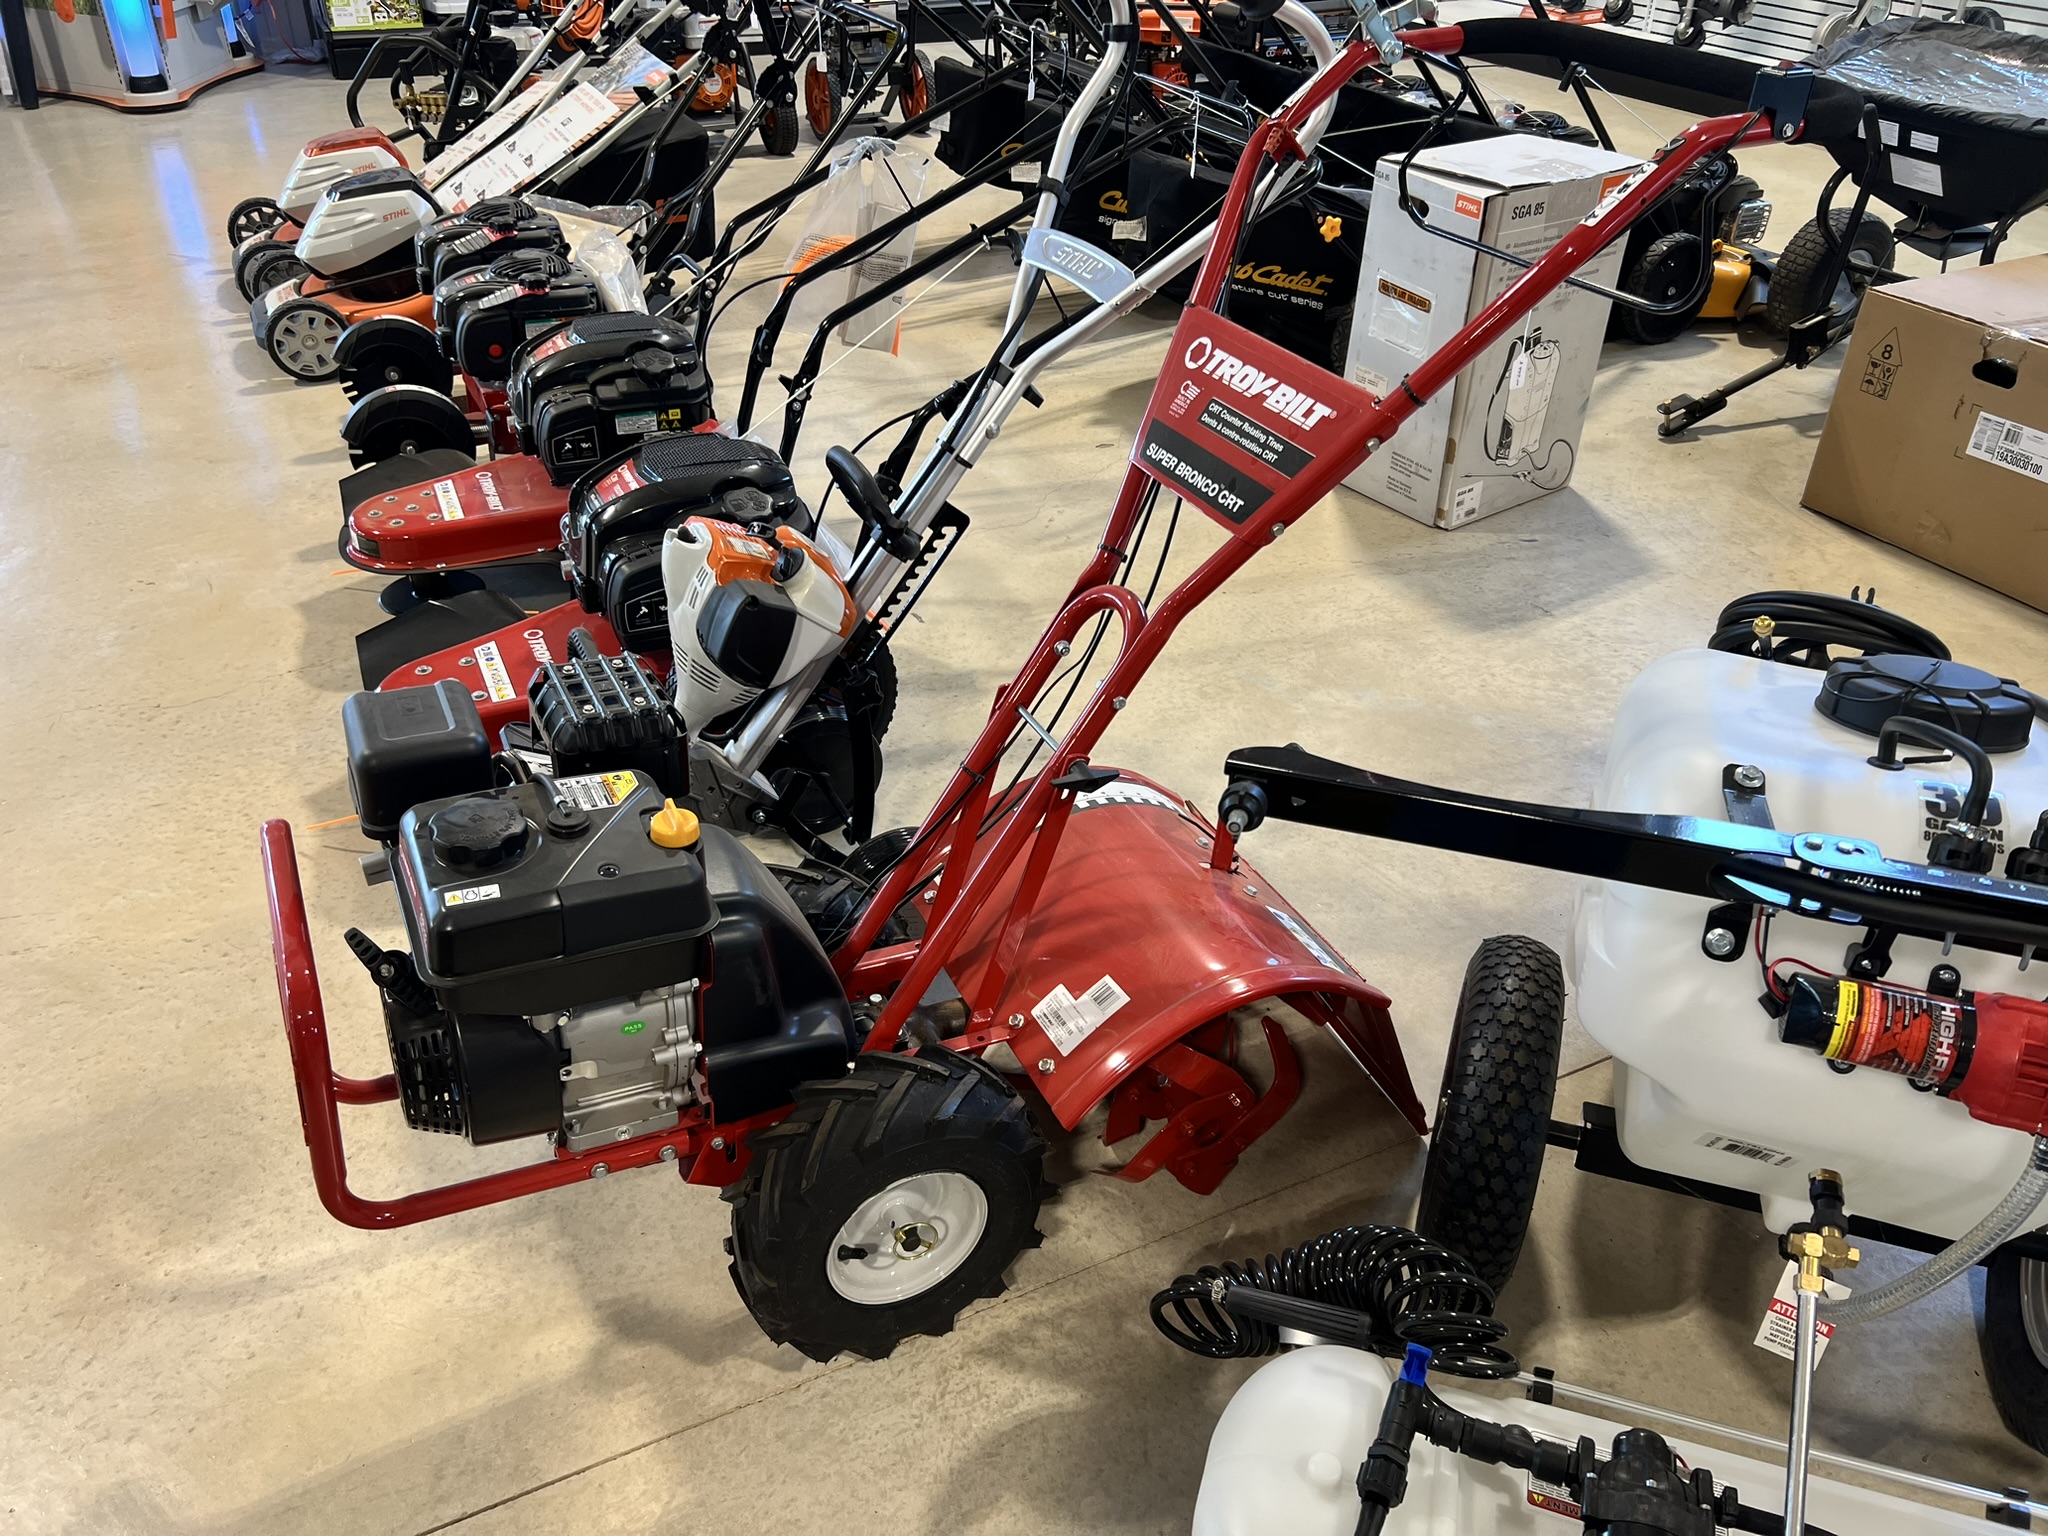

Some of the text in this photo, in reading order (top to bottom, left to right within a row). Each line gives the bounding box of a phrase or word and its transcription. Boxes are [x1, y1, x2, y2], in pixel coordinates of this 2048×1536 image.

[383, 209, 409, 222] STIHL
[1456, 200, 1479, 214] STIHL
[1511, 201, 1545, 220] SGA 85
[1052, 246, 1102, 279] STIHL
[1252, 265, 1334, 295] Cadet
[1231, 283, 1323, 311] ature cut series
[1881, 344, 1894, 360] 8
[1209, 403, 1283, 451] CRT Counter Rotating Tines
[1202, 414, 1217, 427] Dents
[1222, 427, 1262, 454] contre-rotation
[1263, 450, 1277, 462] CRT
[1995, 450, 2043, 476] 19A30030100
[1147, 444, 1244, 511] SUPER BRONCO CRT
[479, 477, 504, 511] TROY-BILT
[624, 1023, 642, 1032] PASS
[1936, 1004, 1957, 1055] HIGH
[1770, 1319, 1792, 1332] STRAINER
[1772, 1302, 1829, 1334] ATTEON
[1775, 1315, 1790, 1325] CHECK
[1763, 1335, 1777, 1344] PUMP
[1769, 1325, 1790, 1337] CLOGGED
[1780, 1335, 1791, 1344] LEAD
[1545, 1500, 1579, 1515] MENT
